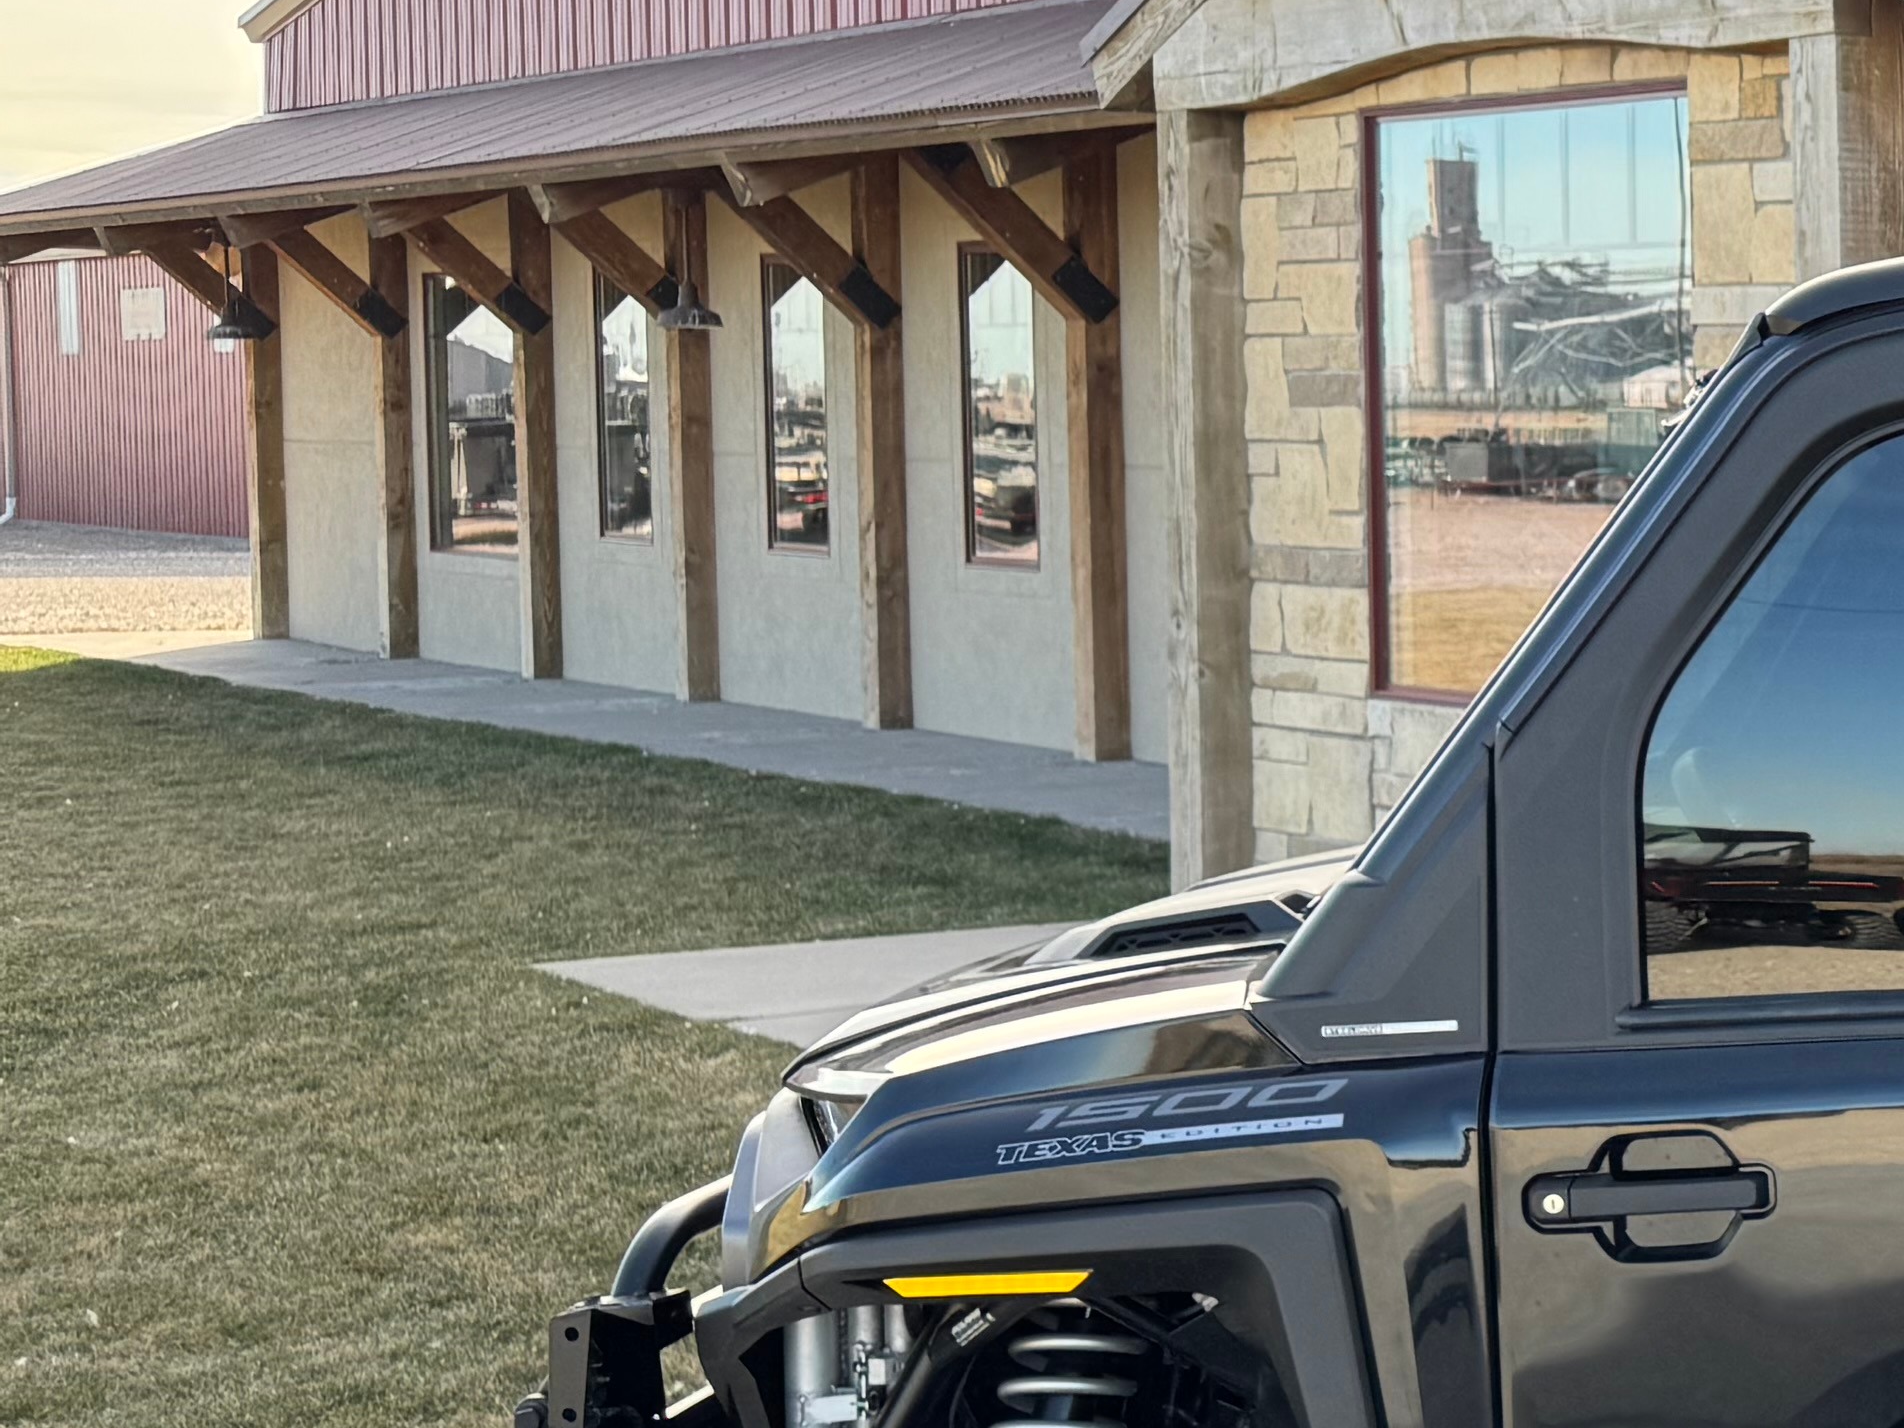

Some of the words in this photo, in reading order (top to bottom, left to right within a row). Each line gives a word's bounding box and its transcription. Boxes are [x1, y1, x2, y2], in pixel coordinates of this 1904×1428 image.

[1026, 1079, 1349, 1132] 1500
[997, 1129, 1148, 1165] TEXAS
[1159, 1117, 1324, 1140] EDITION
